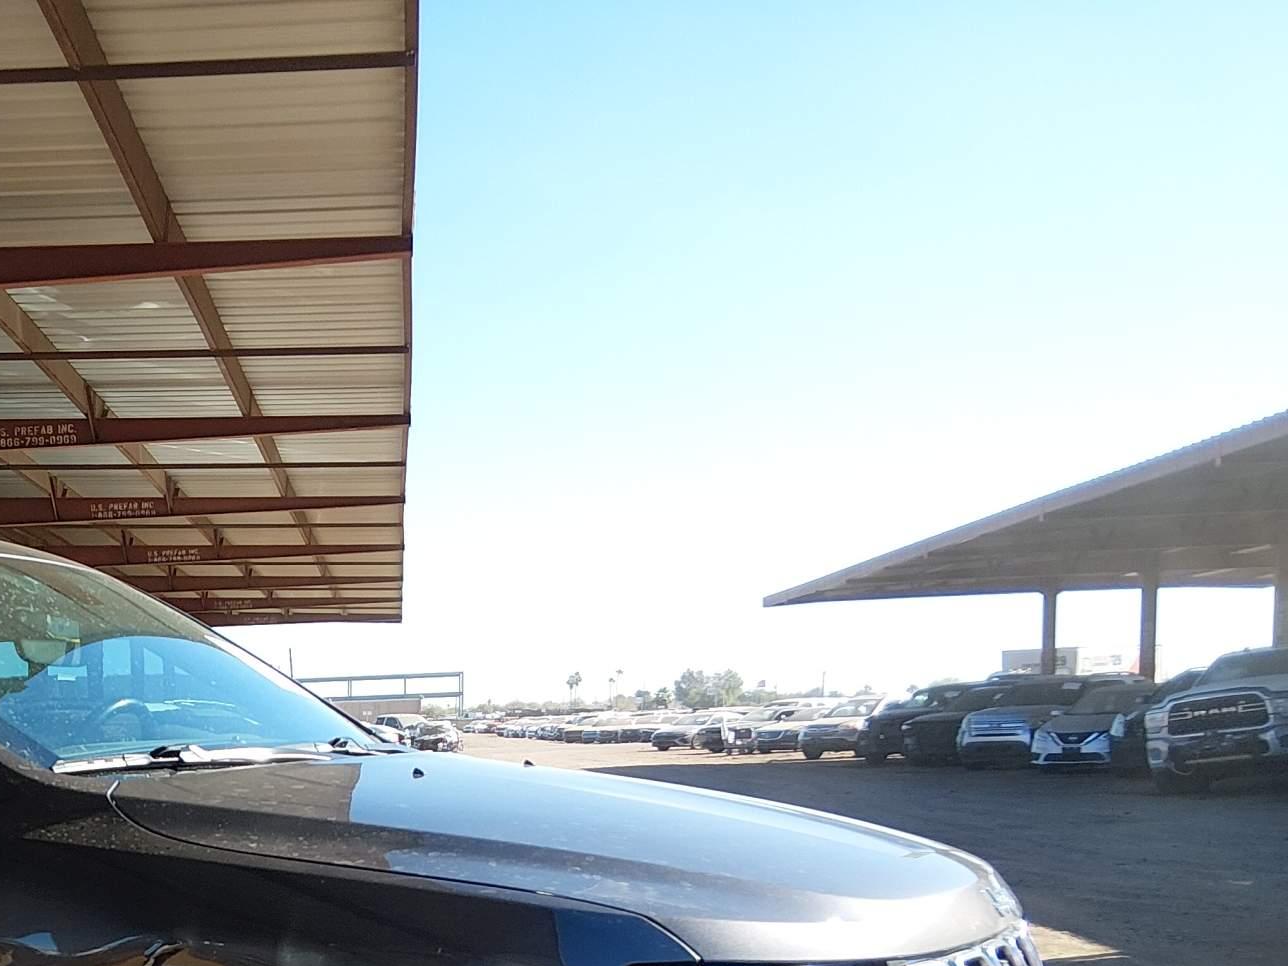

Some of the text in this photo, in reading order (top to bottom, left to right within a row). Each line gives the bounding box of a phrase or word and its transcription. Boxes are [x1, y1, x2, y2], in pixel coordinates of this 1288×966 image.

[14, 424, 54, 437] PREFAB
[57, 422, 78, 434] INC.
[1192, 706, 1238, 717] RAM
